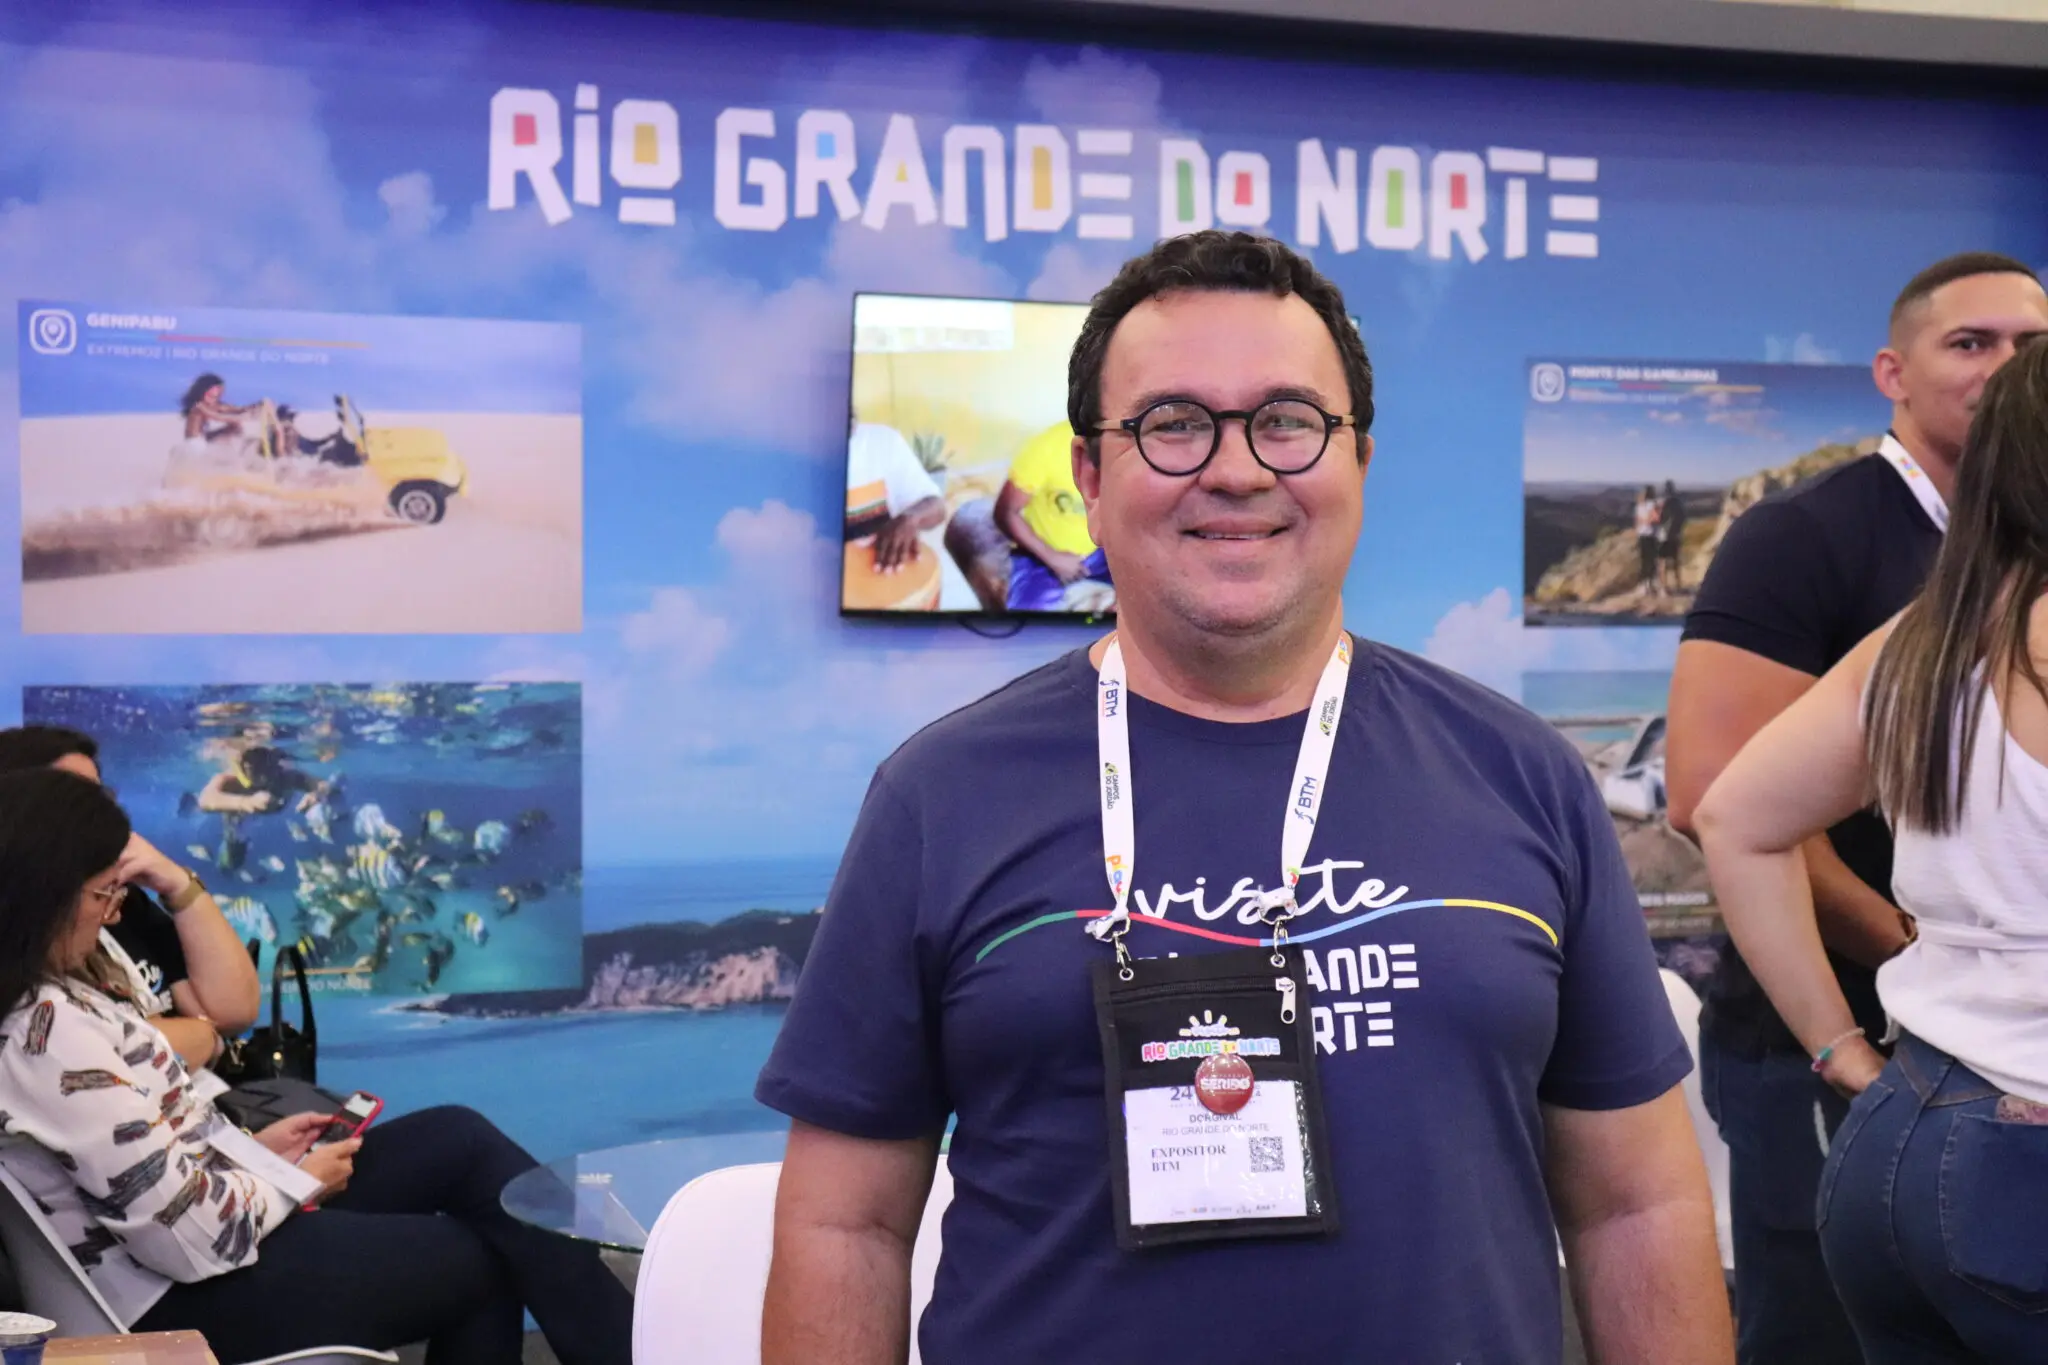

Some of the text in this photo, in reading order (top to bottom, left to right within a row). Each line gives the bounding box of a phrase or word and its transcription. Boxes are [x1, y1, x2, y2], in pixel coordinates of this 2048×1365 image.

[714, 107, 1134, 242] GRANDE
[1160, 139, 1271, 238] DO
[1296, 138, 1599, 263] NORTE
[86, 312, 177, 331] GENIPABU
[1103, 688, 1118, 717] BTM
[1112, 774, 1121, 800] CAMPOS
[1298, 776, 1316, 809] BTM
[1306, 943, 1419, 995] ANDE
[1311, 1002, 1394, 1055] RTE
[1151, 1144, 1226, 1158] EXPOSITOR
